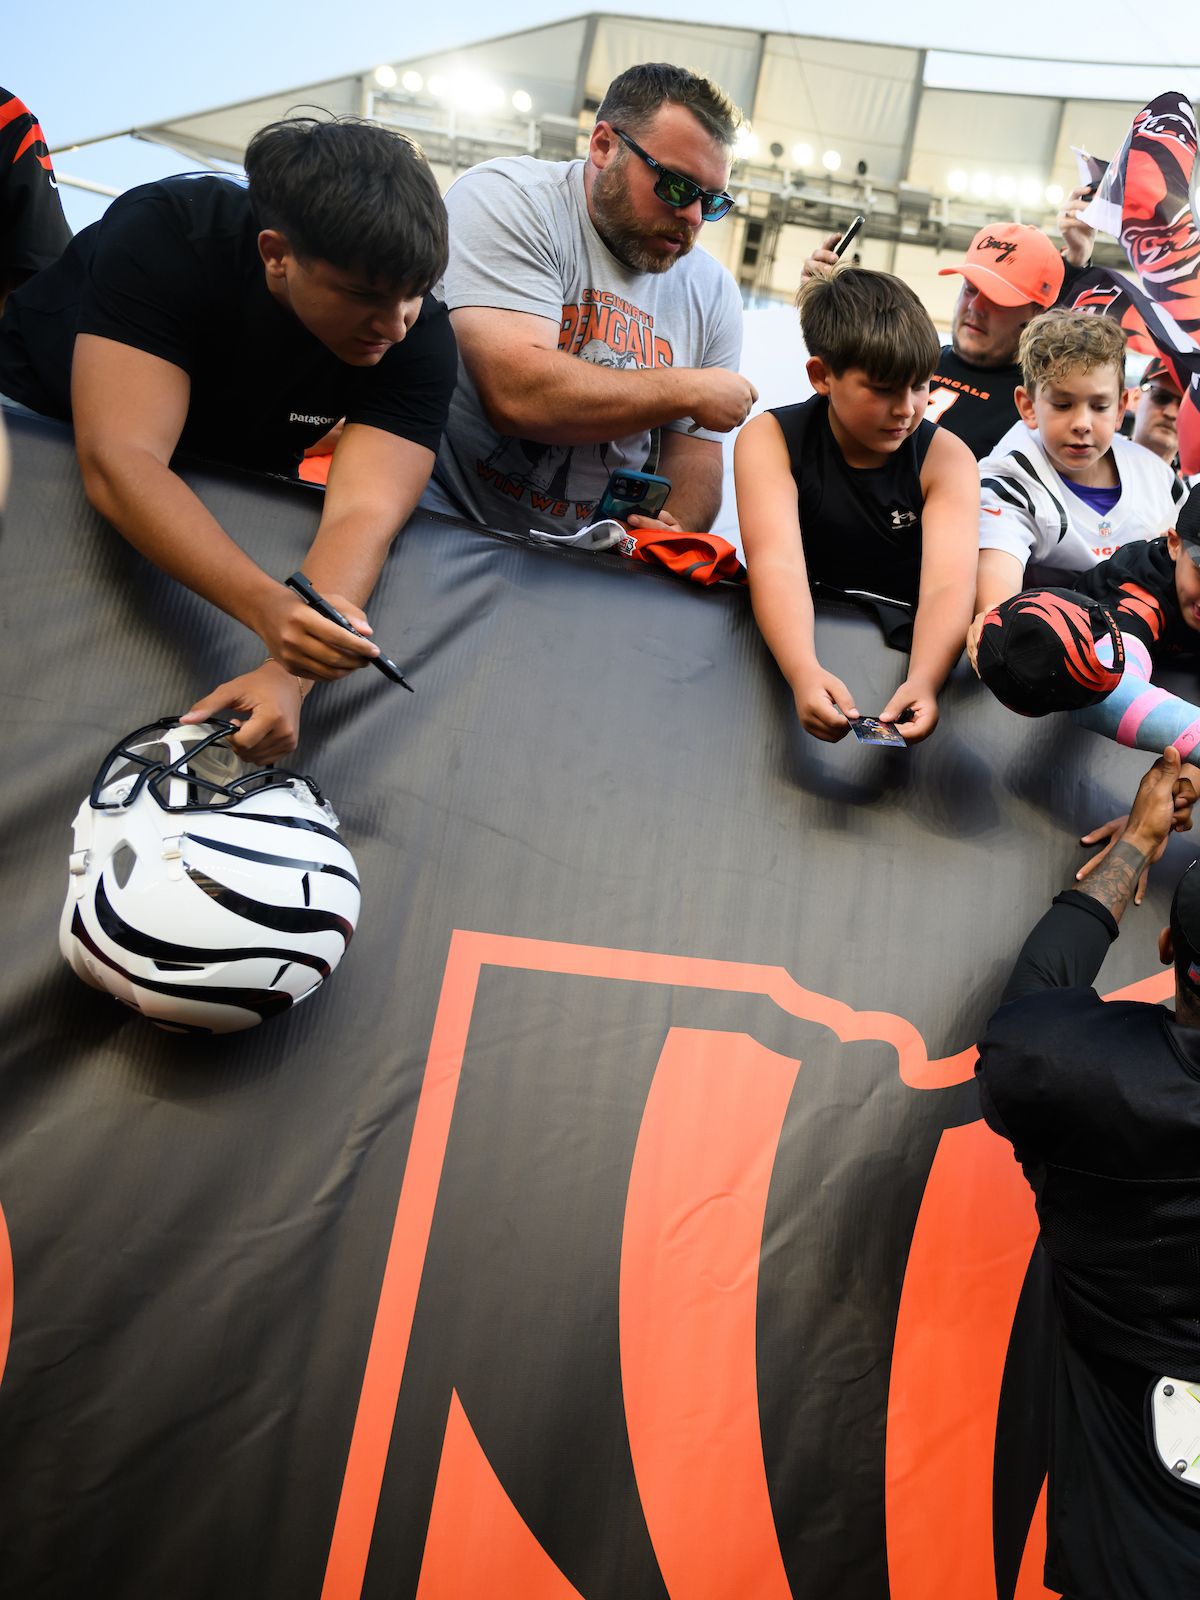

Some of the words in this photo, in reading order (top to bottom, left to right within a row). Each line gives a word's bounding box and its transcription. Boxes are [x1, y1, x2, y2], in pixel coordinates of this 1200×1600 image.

[582, 288, 654, 328] CNCINNATI
[931, 374, 990, 400] ENGALS
[289, 412, 335, 425] patagon
